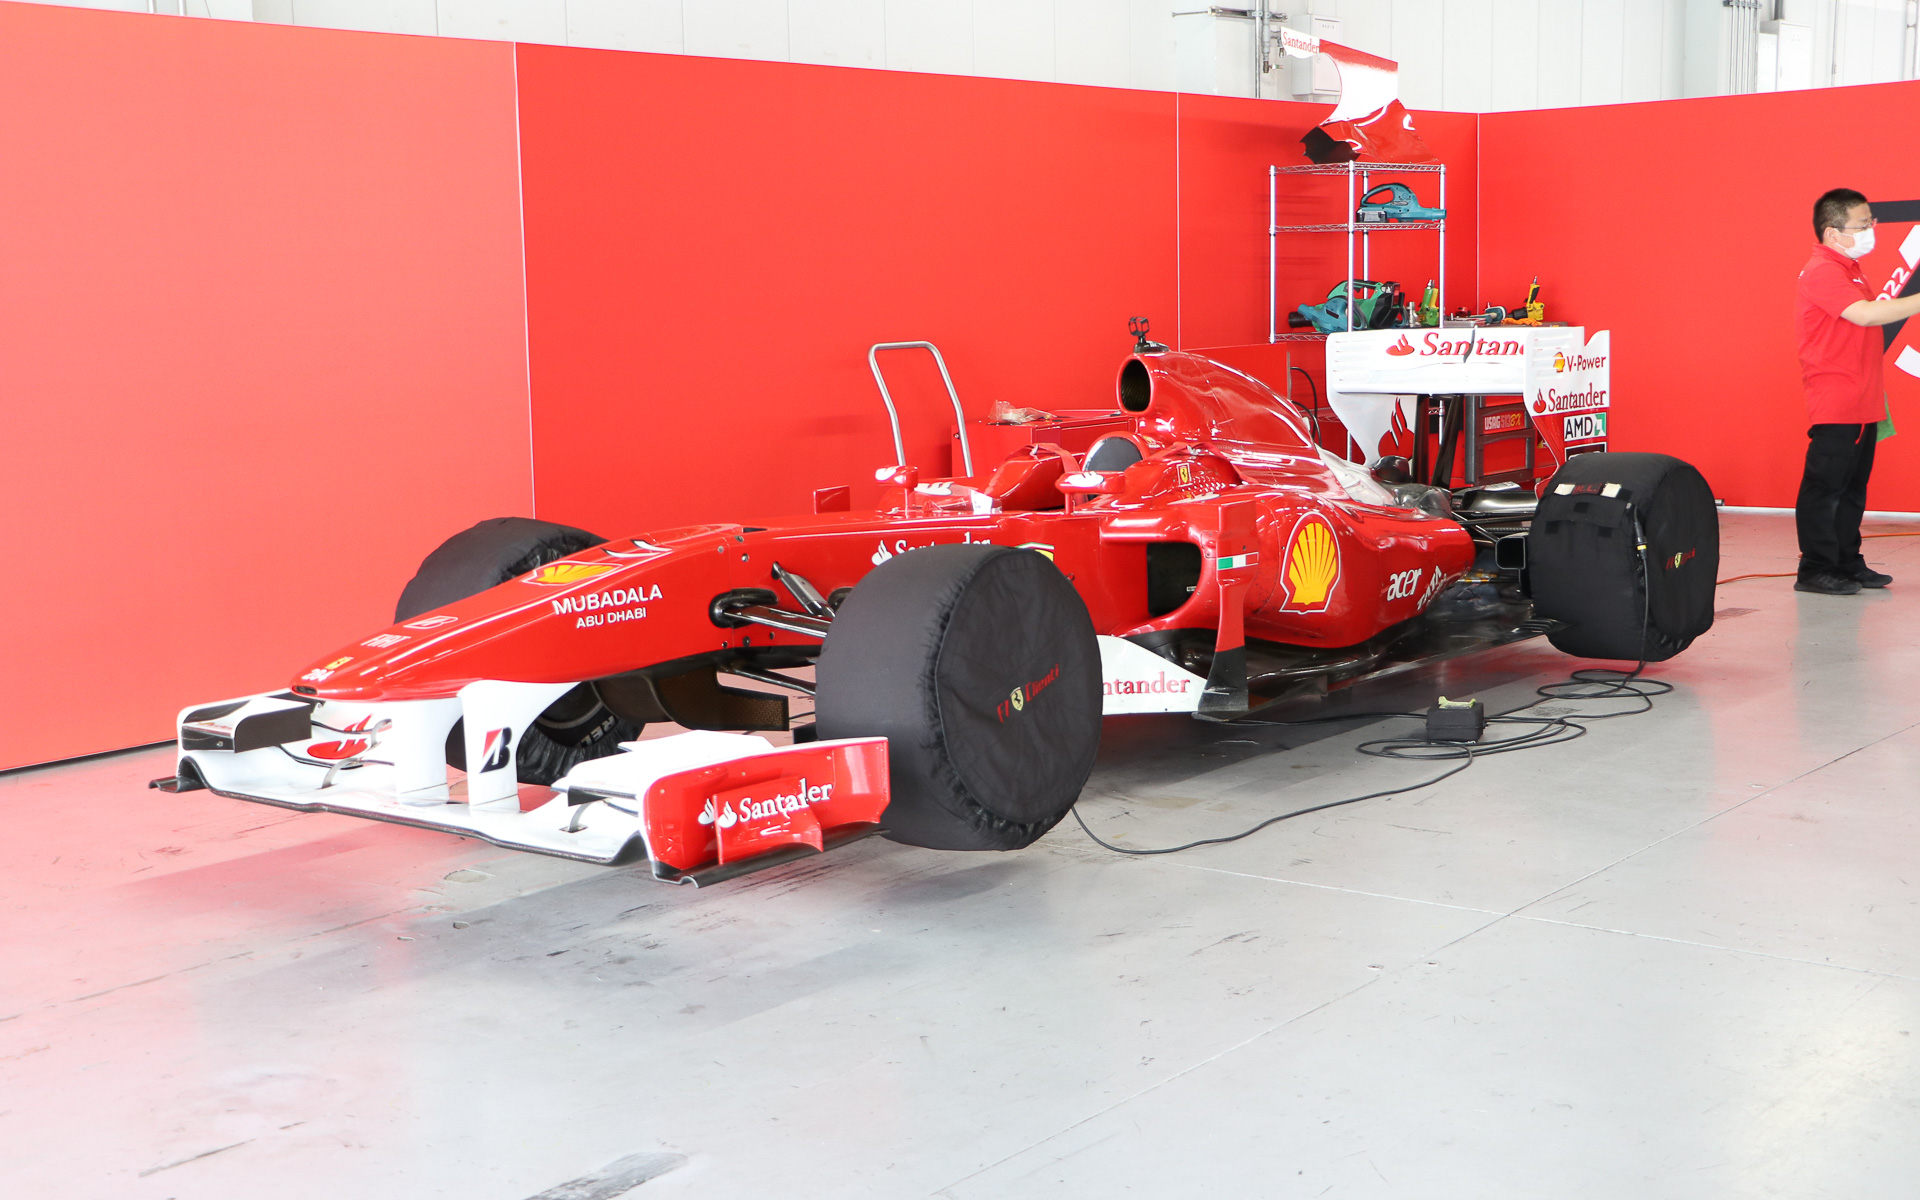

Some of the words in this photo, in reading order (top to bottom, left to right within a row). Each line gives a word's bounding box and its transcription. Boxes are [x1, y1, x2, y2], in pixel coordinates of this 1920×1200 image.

[1282, 31, 1319, 54] Santander
[1566, 354, 1606, 372] V-Power
[1548, 382, 1606, 412] Santander
[1565, 416, 1593, 439] AMD
[1386, 568, 1422, 602] acer
[552, 584, 663, 615] MUBADALA
[576, 614, 604, 629] ABU
[607, 607, 647, 623] DHABI
[360, 634, 412, 648] FIAT
